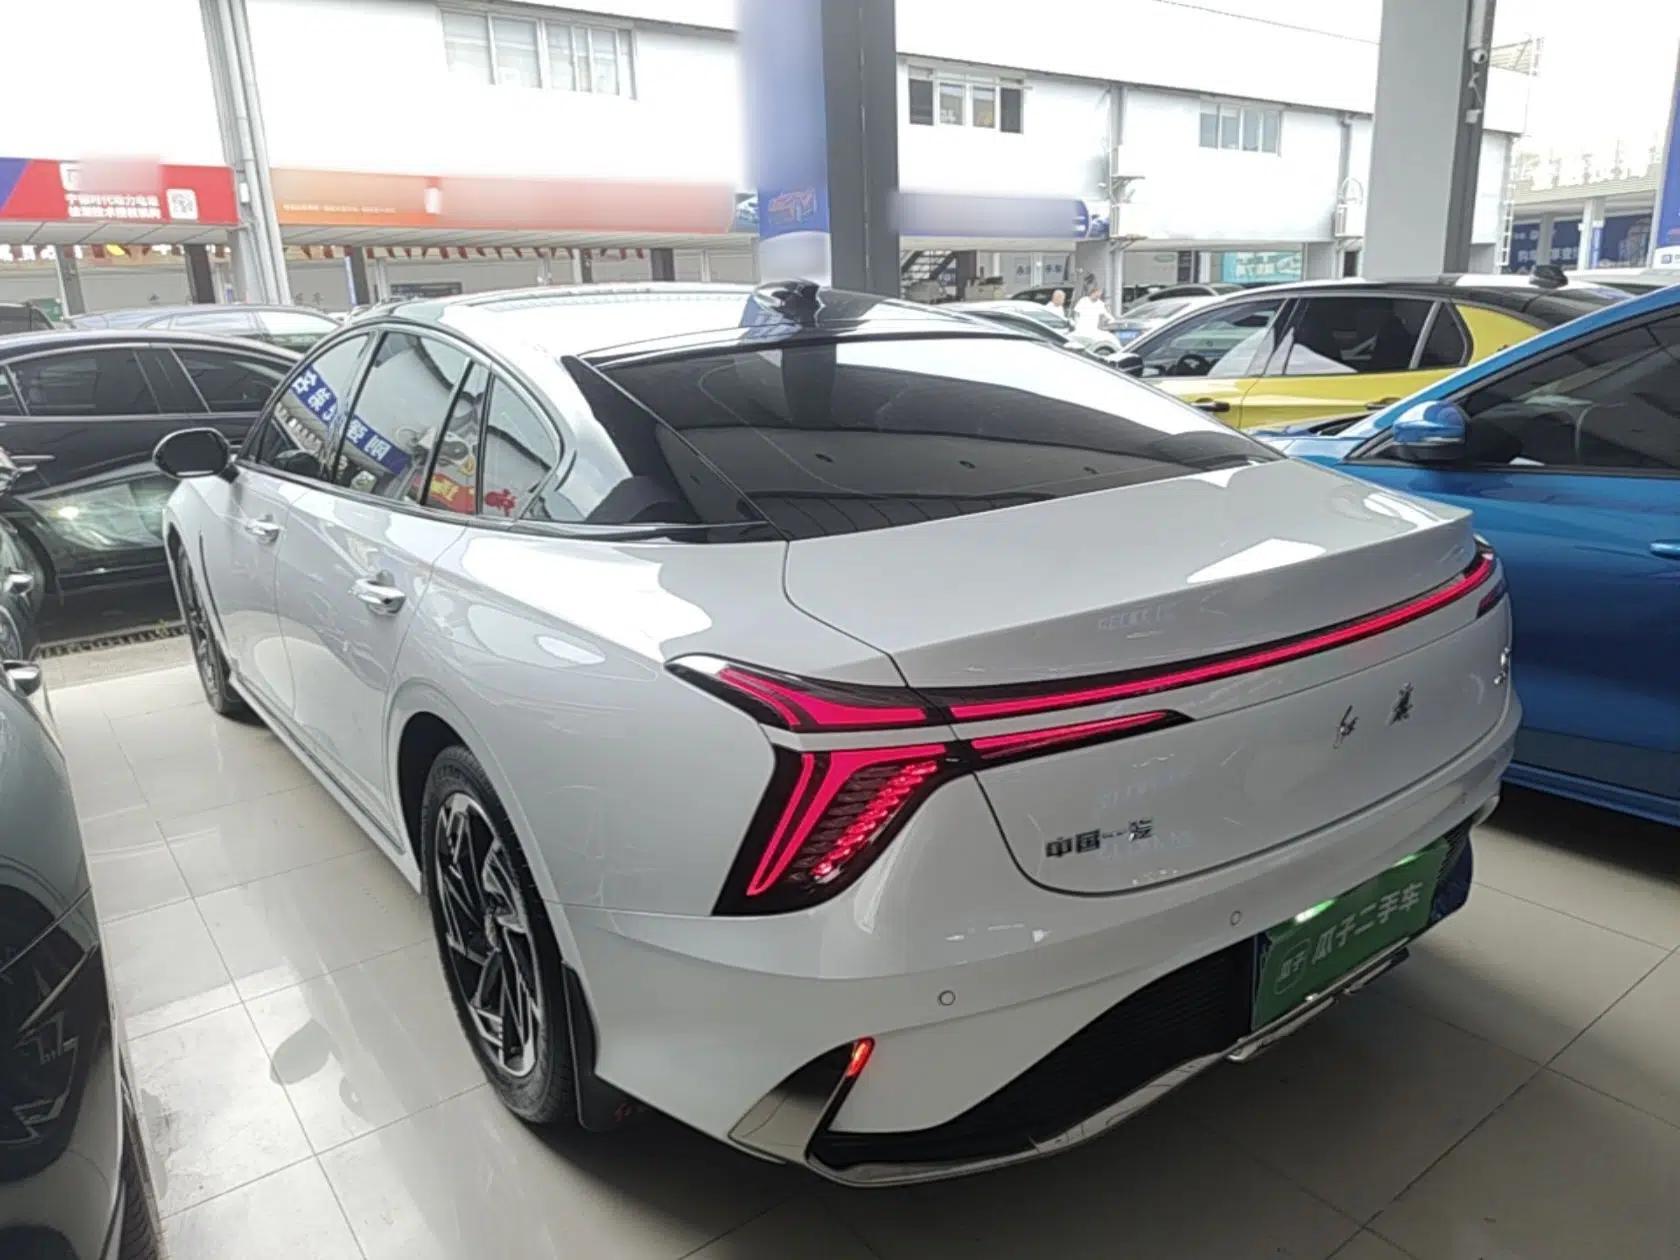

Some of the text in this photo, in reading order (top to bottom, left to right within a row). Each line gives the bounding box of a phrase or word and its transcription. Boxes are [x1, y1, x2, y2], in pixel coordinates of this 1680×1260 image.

[1046, 818, 1153, 857] 中国一汽
[1312, 882, 1424, 964] 瓜子二手车
